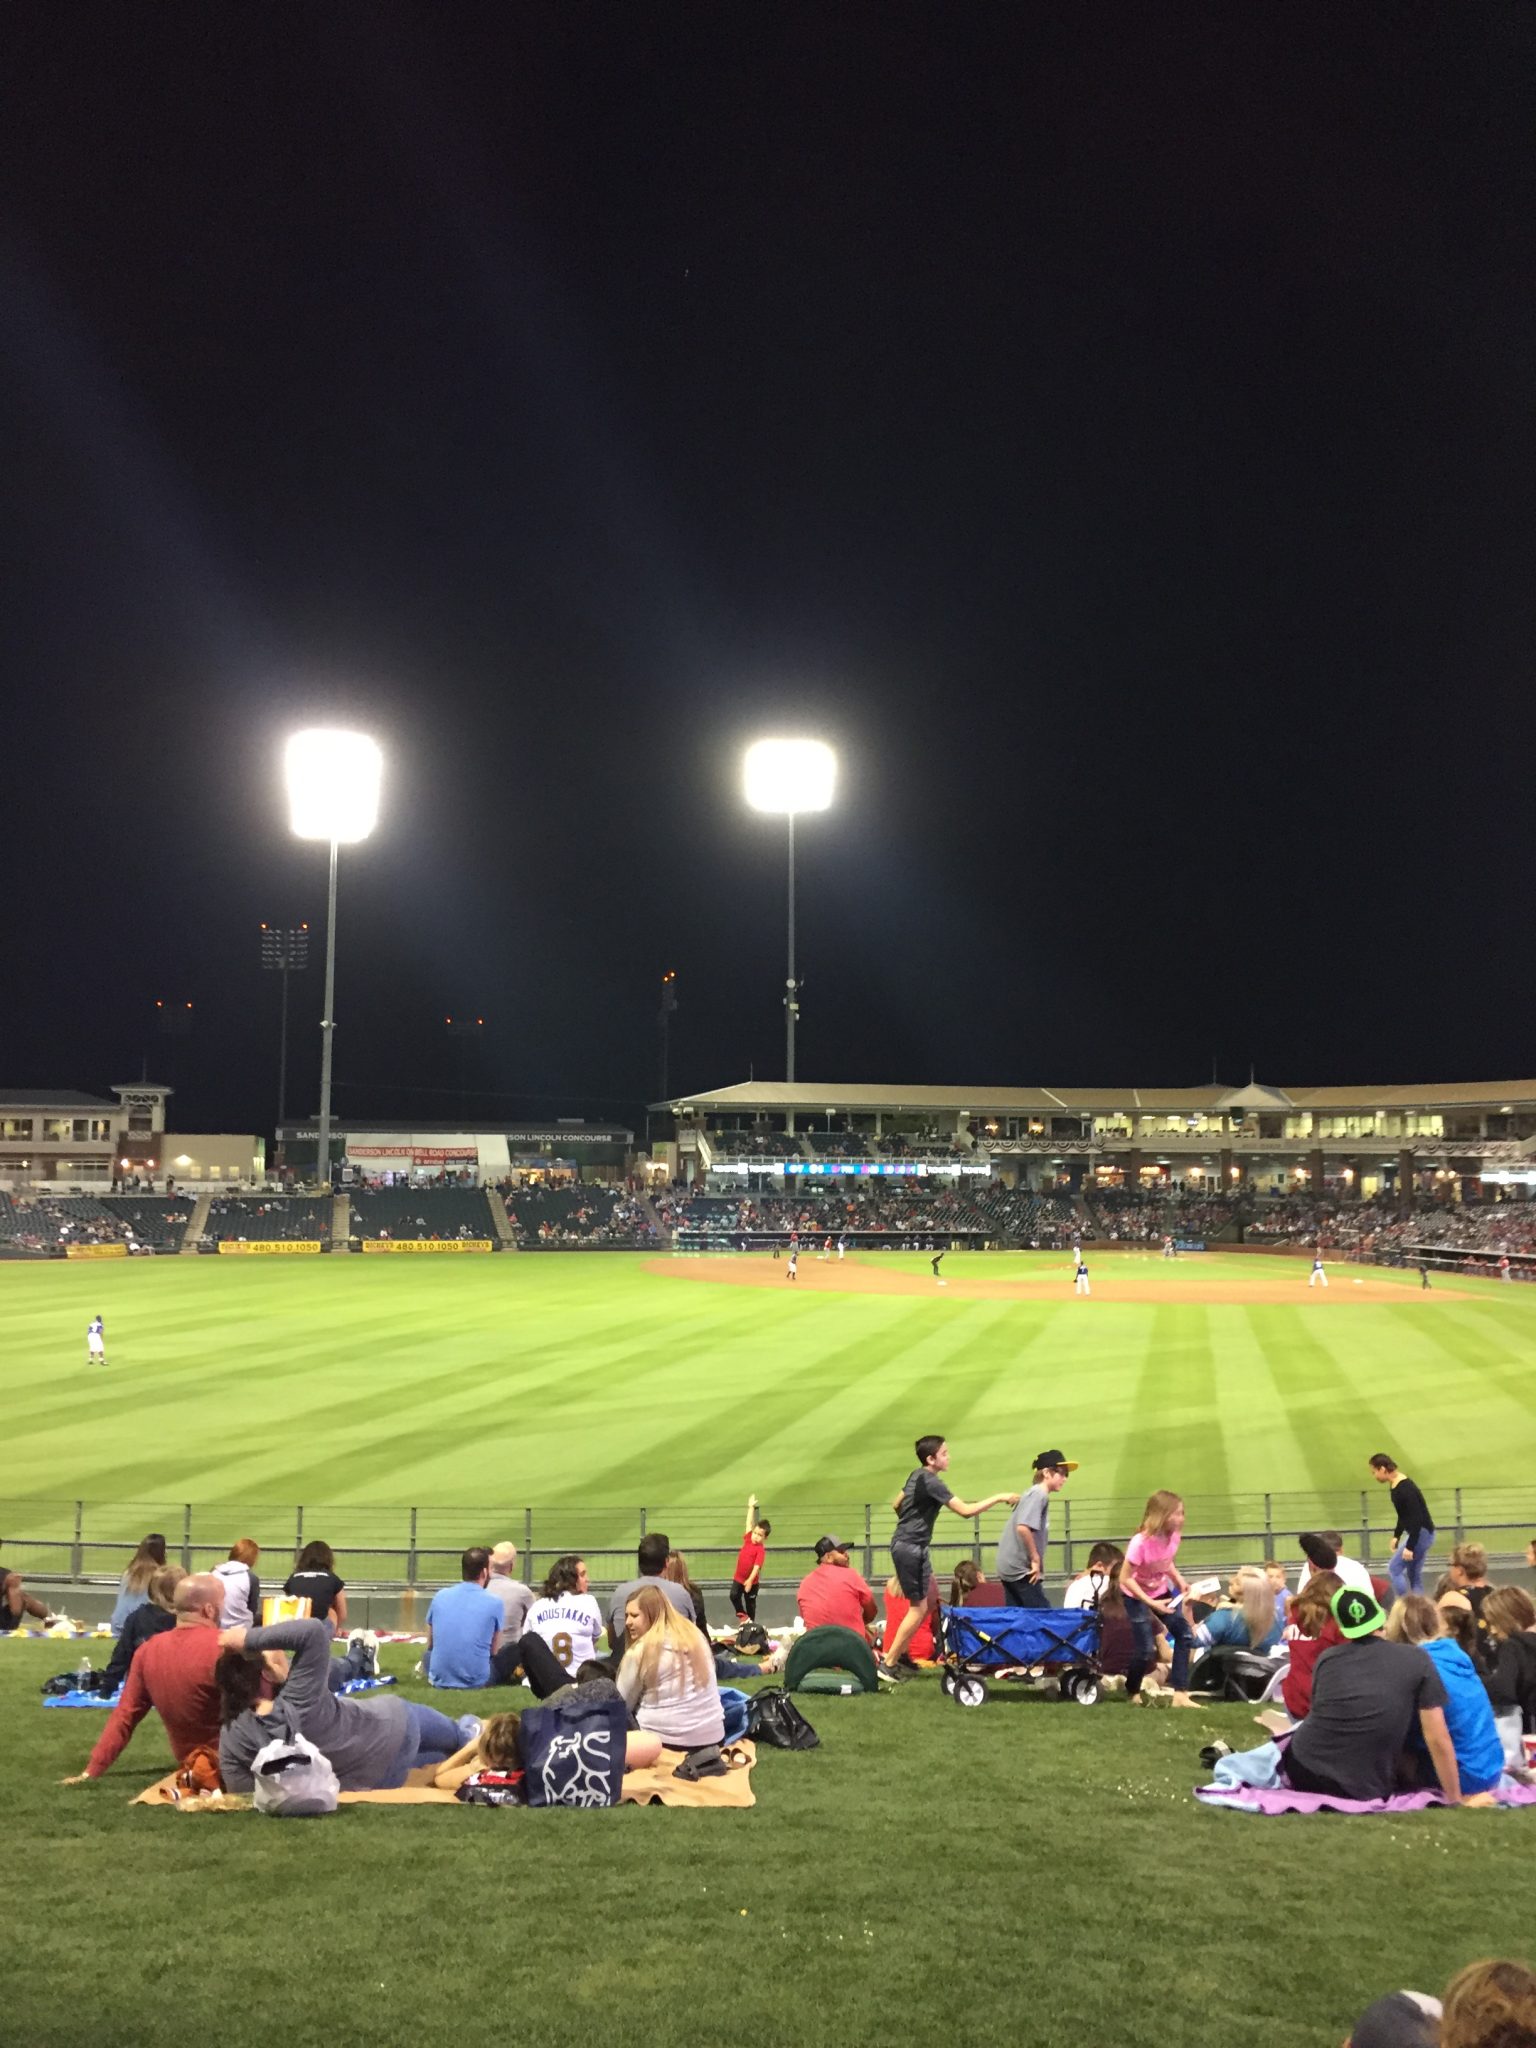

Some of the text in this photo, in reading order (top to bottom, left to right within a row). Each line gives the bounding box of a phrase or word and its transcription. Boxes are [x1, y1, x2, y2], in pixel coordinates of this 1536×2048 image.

[563, 1134, 612, 1142] CONCOURSE
[296, 1243, 318, 1252] 1050
[396, 1242, 414, 1251] 480
[417, 1242, 435, 1251] 510
[437, 1242, 459, 1251] 1050
[537, 1608, 591, 1626] MOUSTAKAS
[552, 1631, 573, 1667] 8
